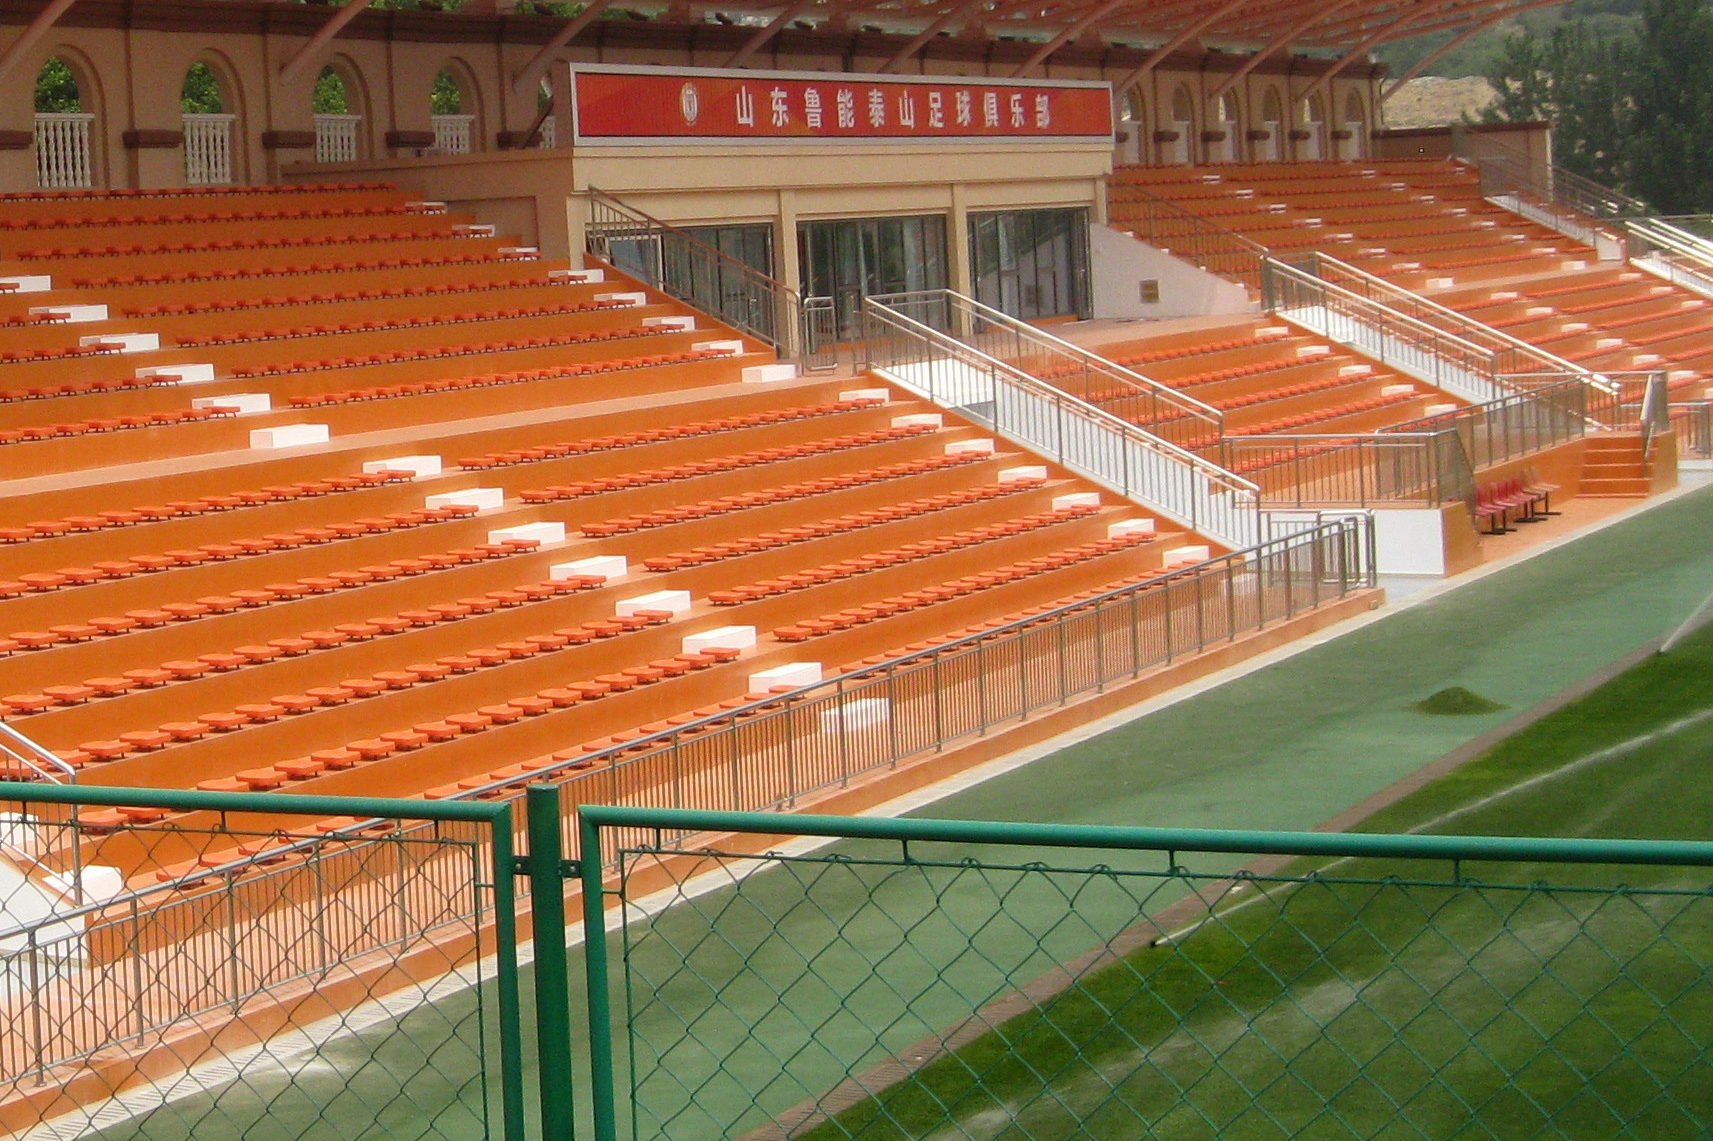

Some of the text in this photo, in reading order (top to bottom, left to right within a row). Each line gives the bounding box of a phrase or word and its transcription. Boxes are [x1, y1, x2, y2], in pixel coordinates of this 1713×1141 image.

[735, 84, 1051, 129] 山东鲁能泰山足球俱乐部
